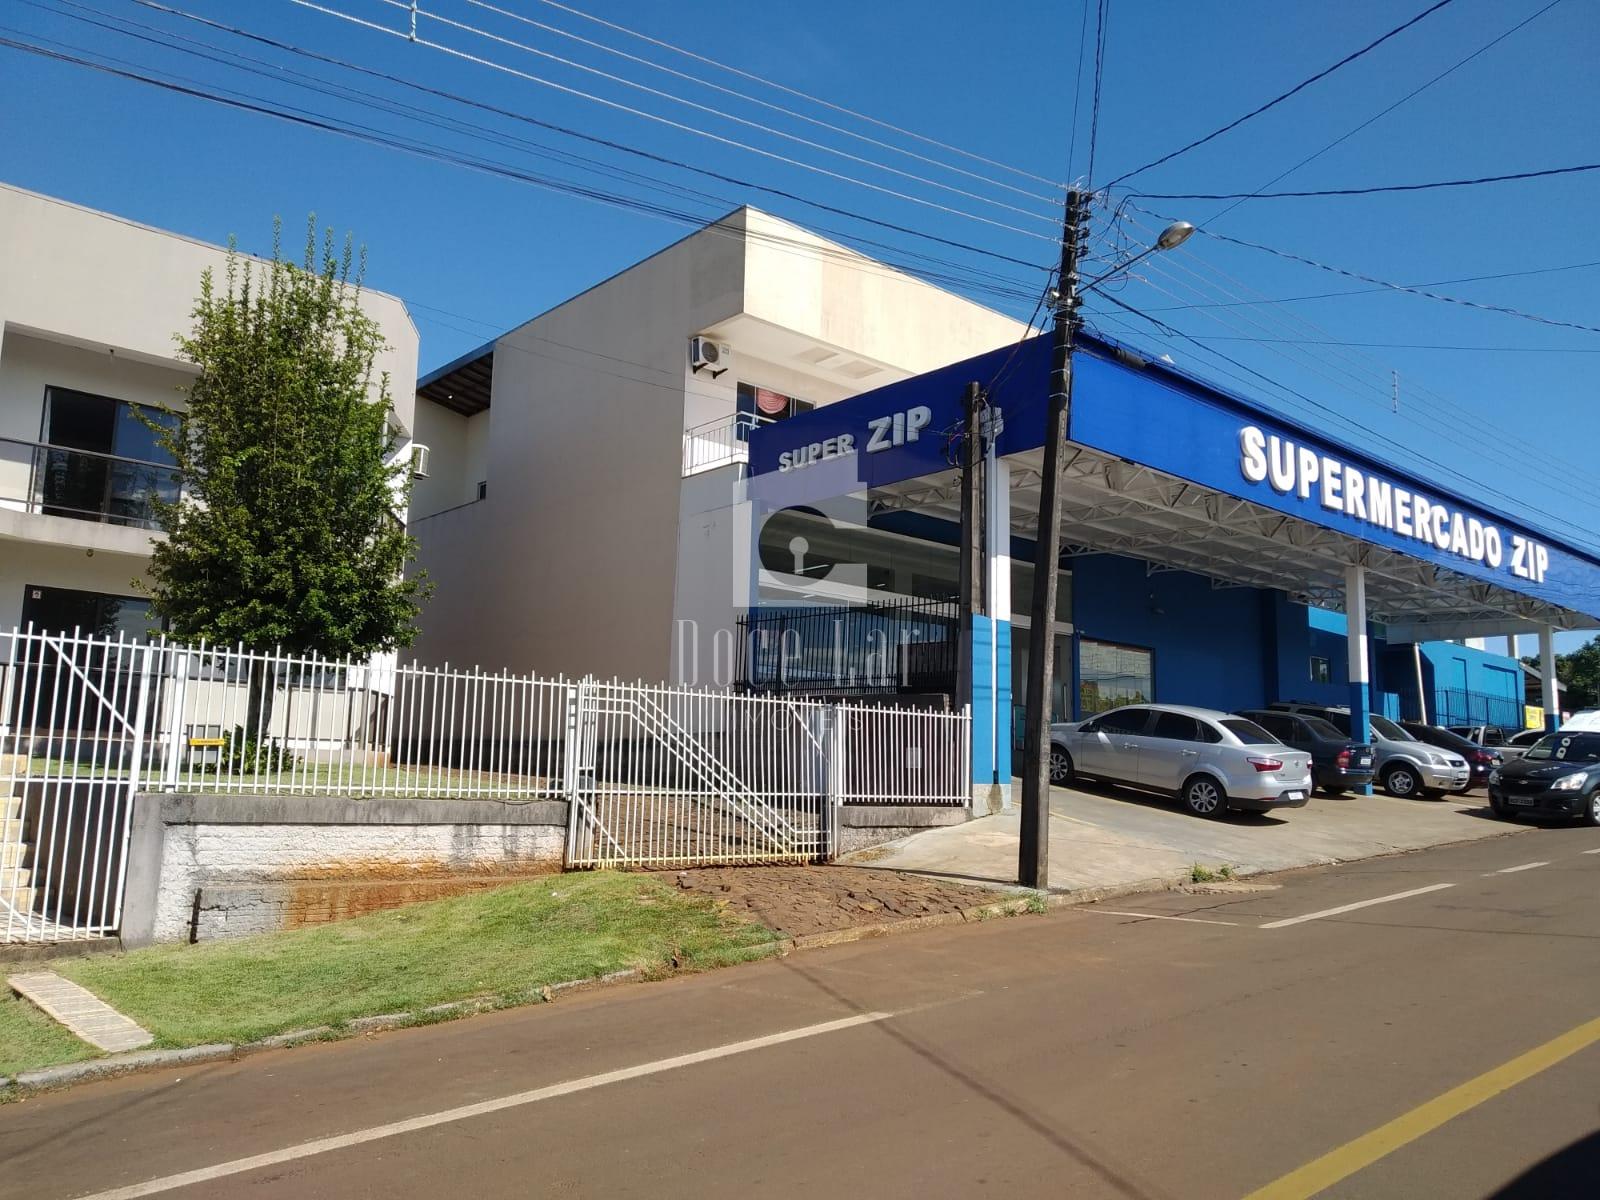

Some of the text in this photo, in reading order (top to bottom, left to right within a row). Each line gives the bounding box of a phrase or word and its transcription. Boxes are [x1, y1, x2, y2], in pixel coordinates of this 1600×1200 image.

[778, 405, 932, 473] SUPER ZIP
[1240, 425, 1549, 584] SUPERMERCADO ZIP
